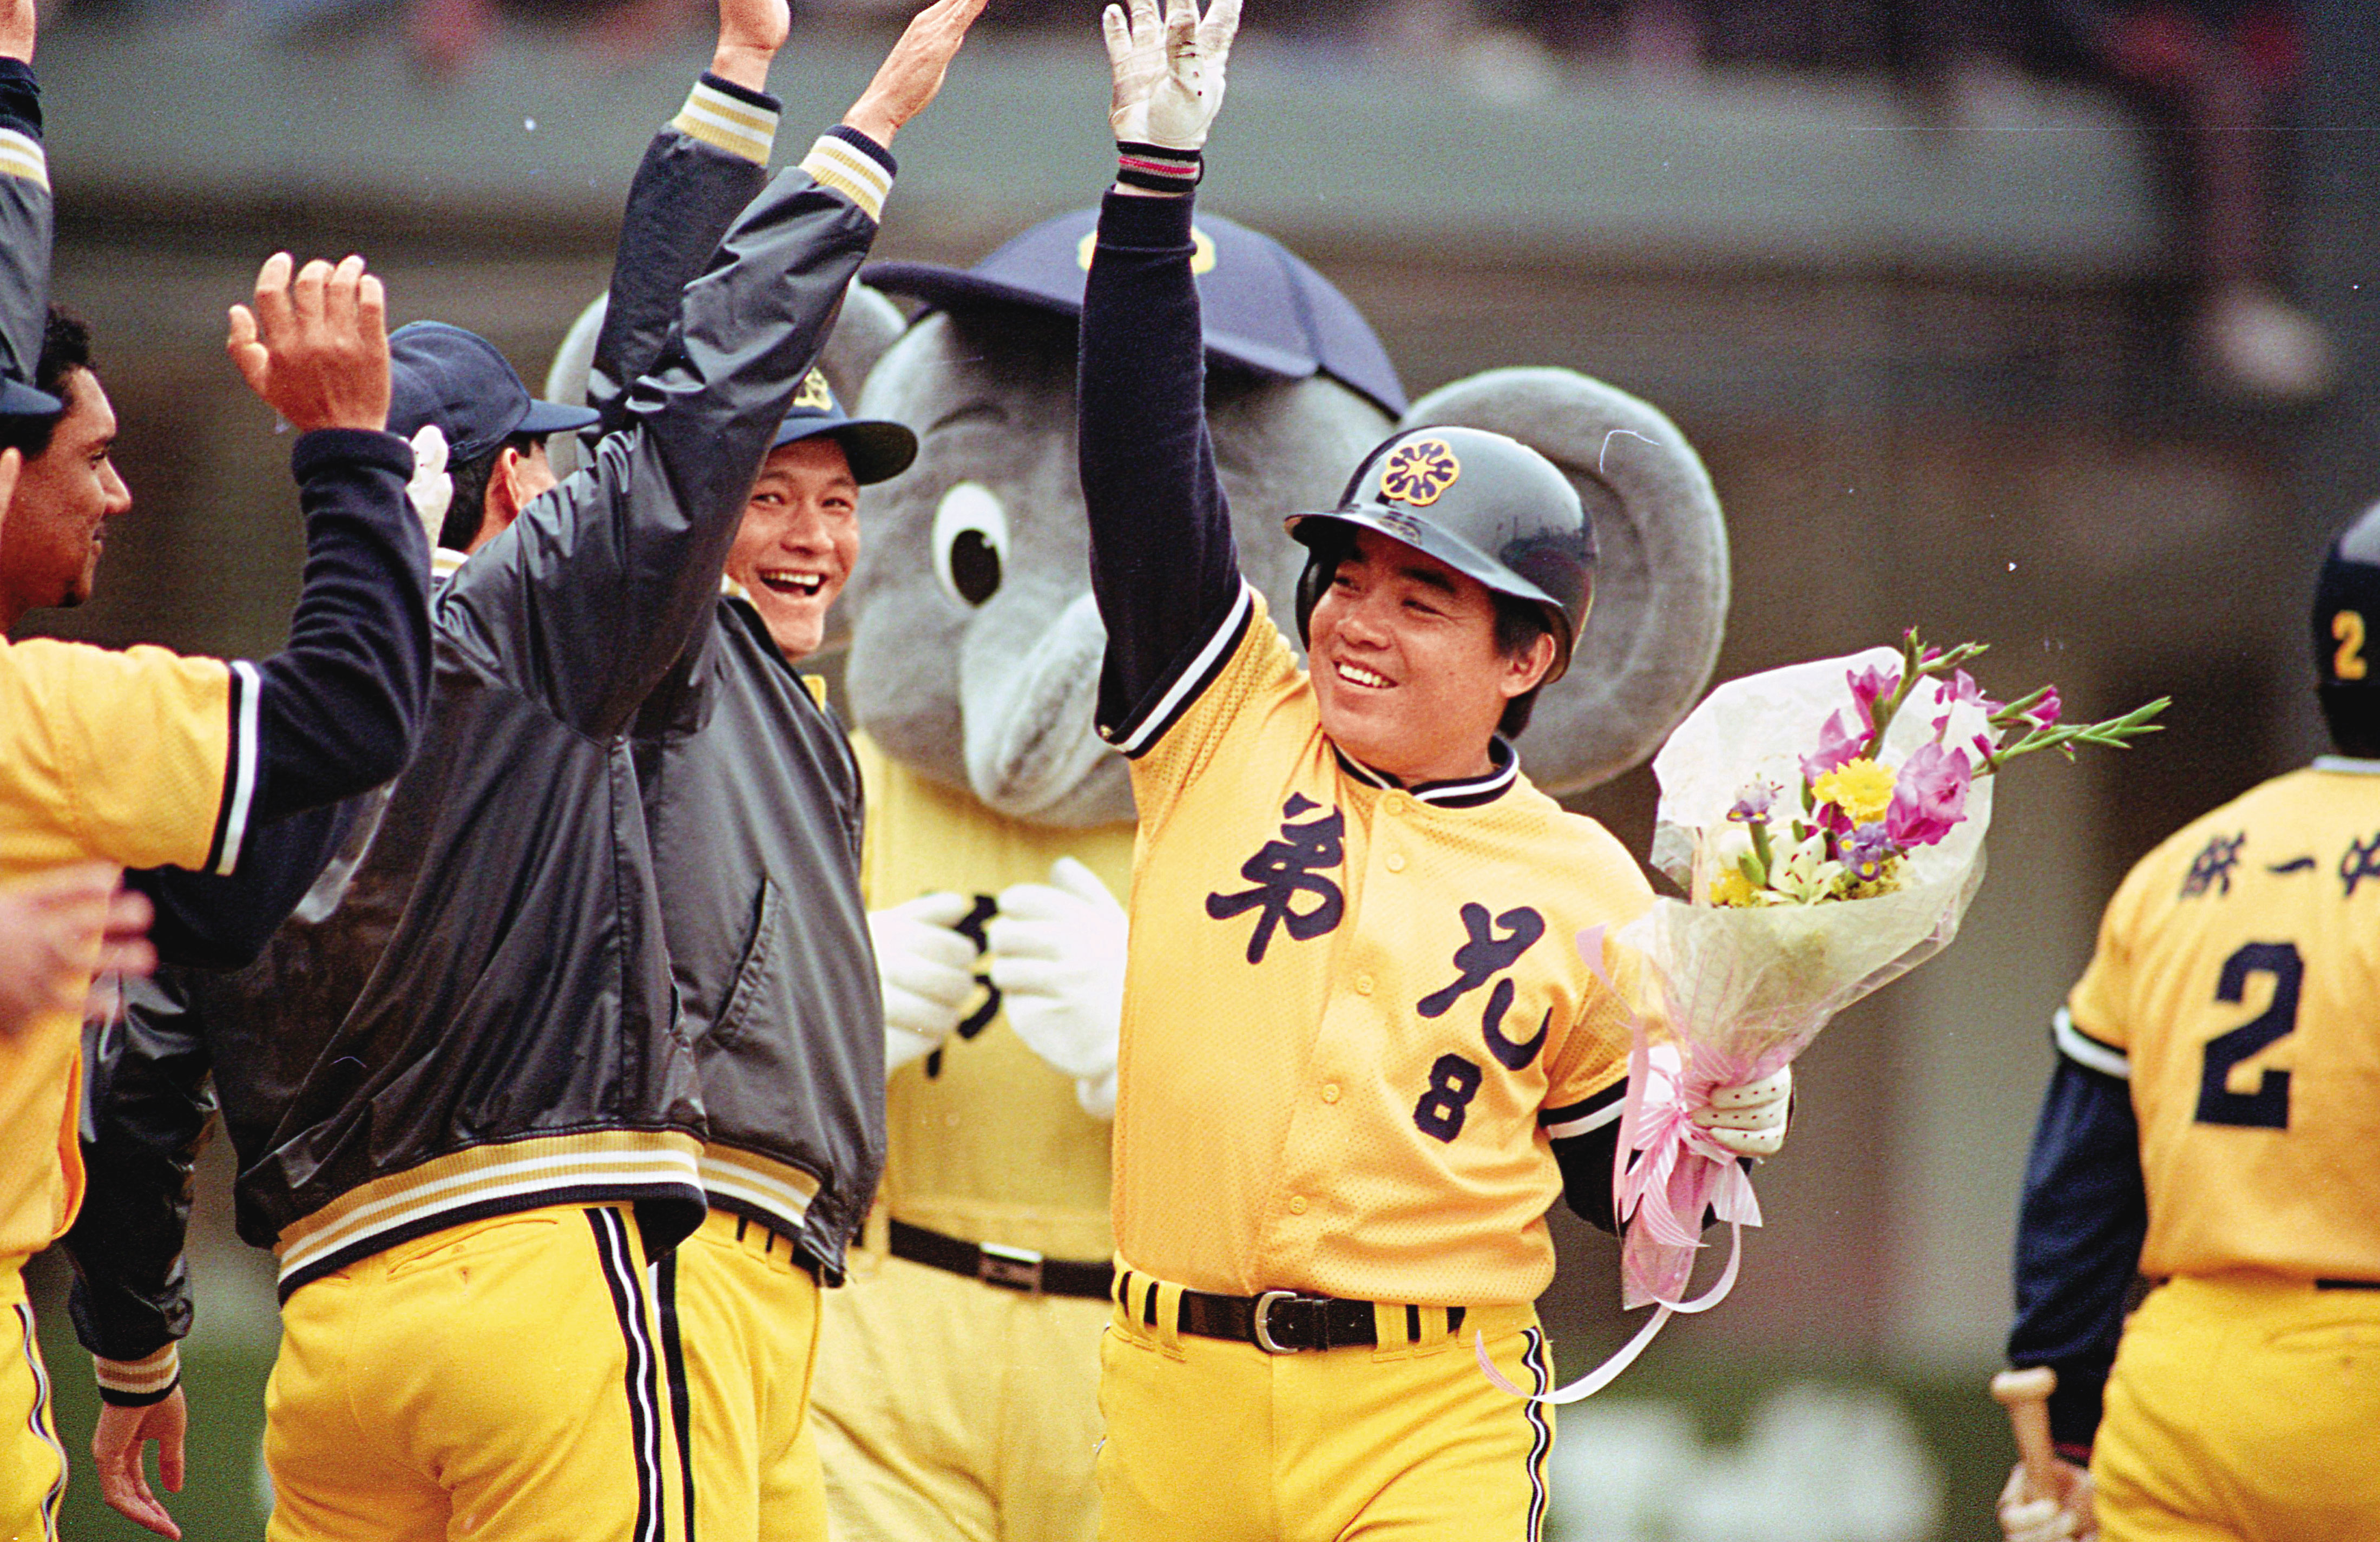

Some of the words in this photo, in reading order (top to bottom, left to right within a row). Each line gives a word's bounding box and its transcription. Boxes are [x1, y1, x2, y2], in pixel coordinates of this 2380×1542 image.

[2331, 609, 2366, 680] 2
[2194, 942, 2304, 1131] 2
[1413, 1053, 1483, 1144] 8
